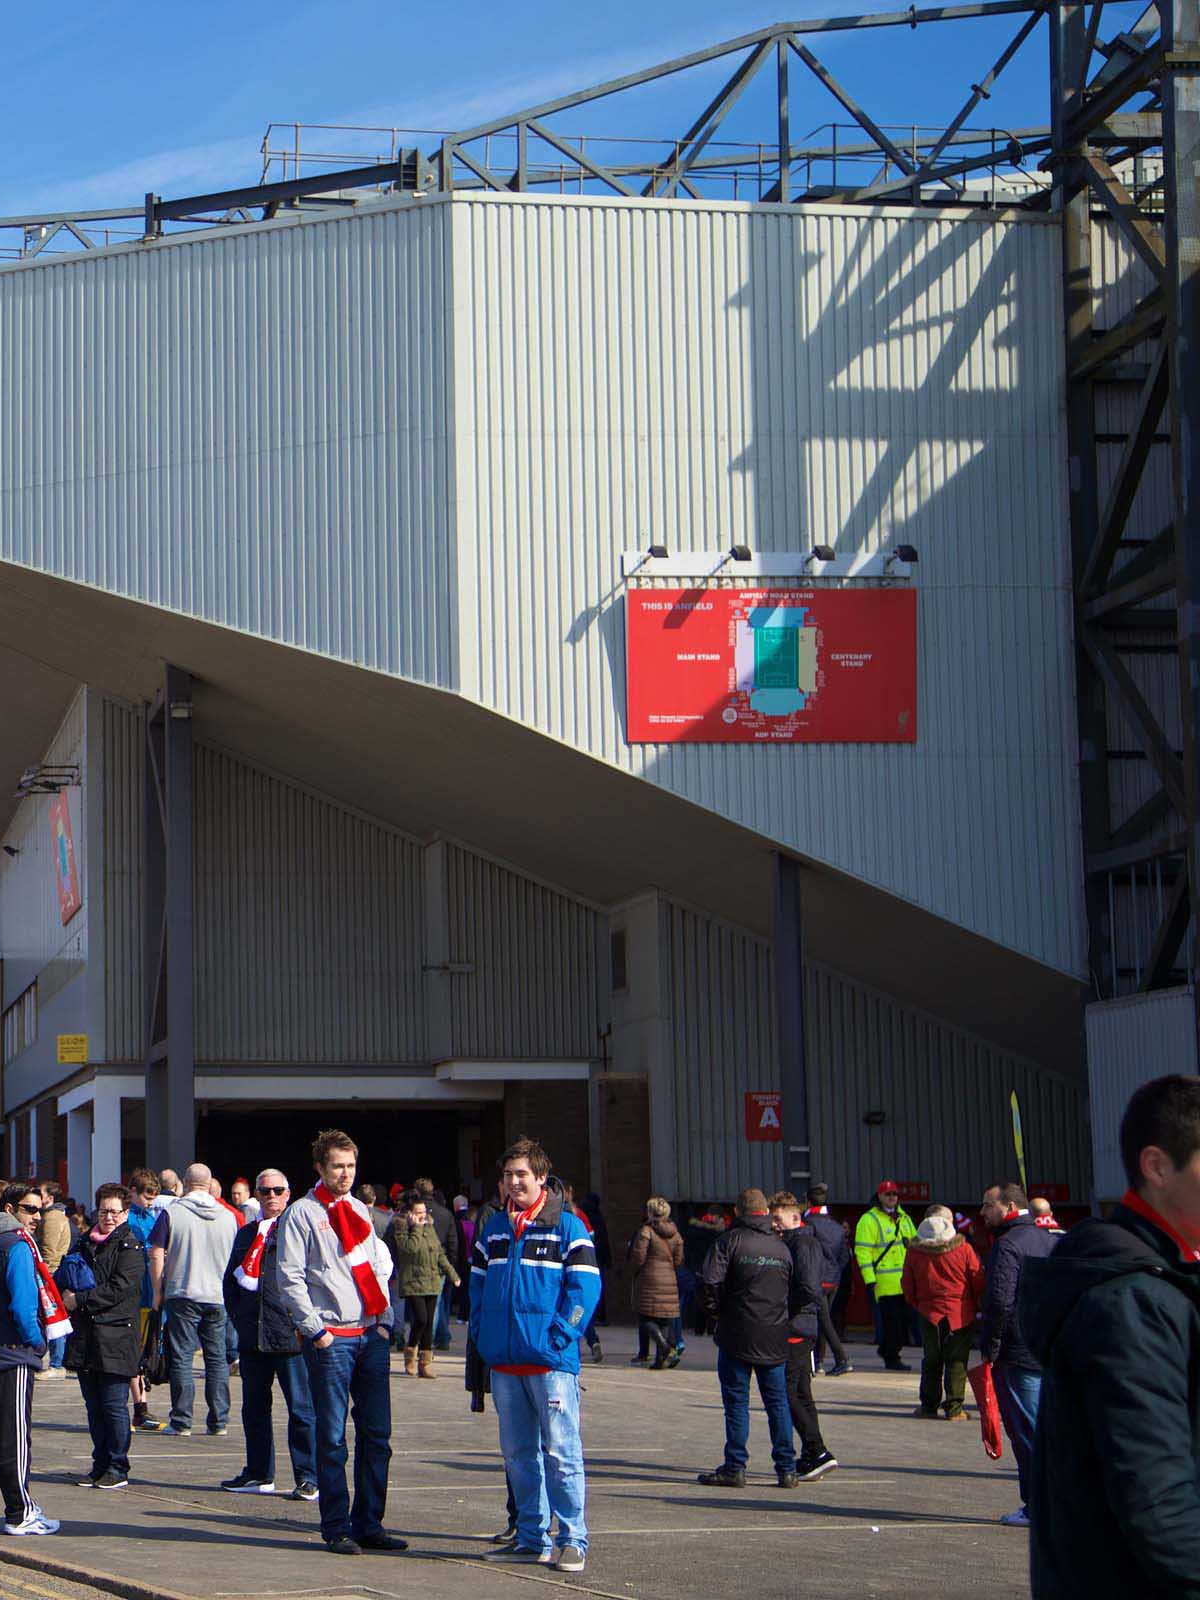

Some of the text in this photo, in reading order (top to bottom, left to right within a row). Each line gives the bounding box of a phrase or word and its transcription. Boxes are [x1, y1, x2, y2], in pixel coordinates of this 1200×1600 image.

[642, 602, 713, 610] THIS IS ANFIELD
[760, 1107, 780, 1128] A
